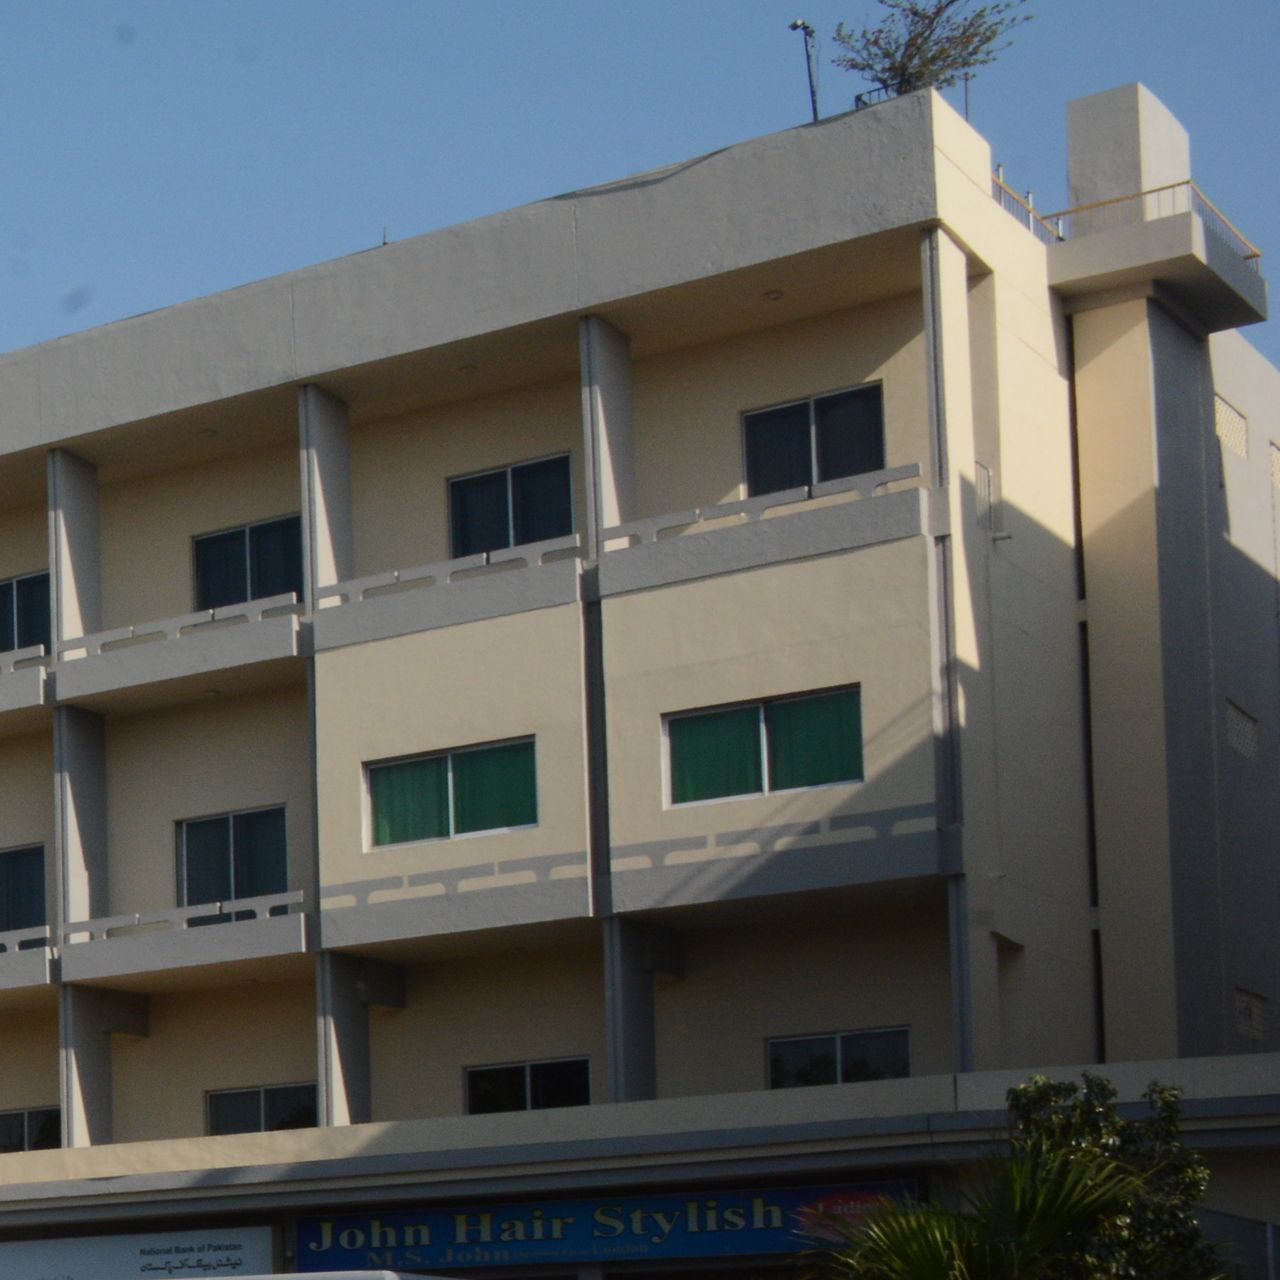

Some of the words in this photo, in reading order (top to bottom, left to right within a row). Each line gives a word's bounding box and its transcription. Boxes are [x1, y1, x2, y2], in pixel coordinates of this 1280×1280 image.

[308, 1218, 432, 1251] John
[454, 1208, 576, 1244] Hair
[592, 1196, 785, 1243] Stylish
[140, 1247, 172, 1256] National
[174, 1246, 195, 1254] Bank
[197, 1244, 206, 1252] of
[207, 1243, 242, 1252] Pakistan
[438, 1247, 511, 1264] John
